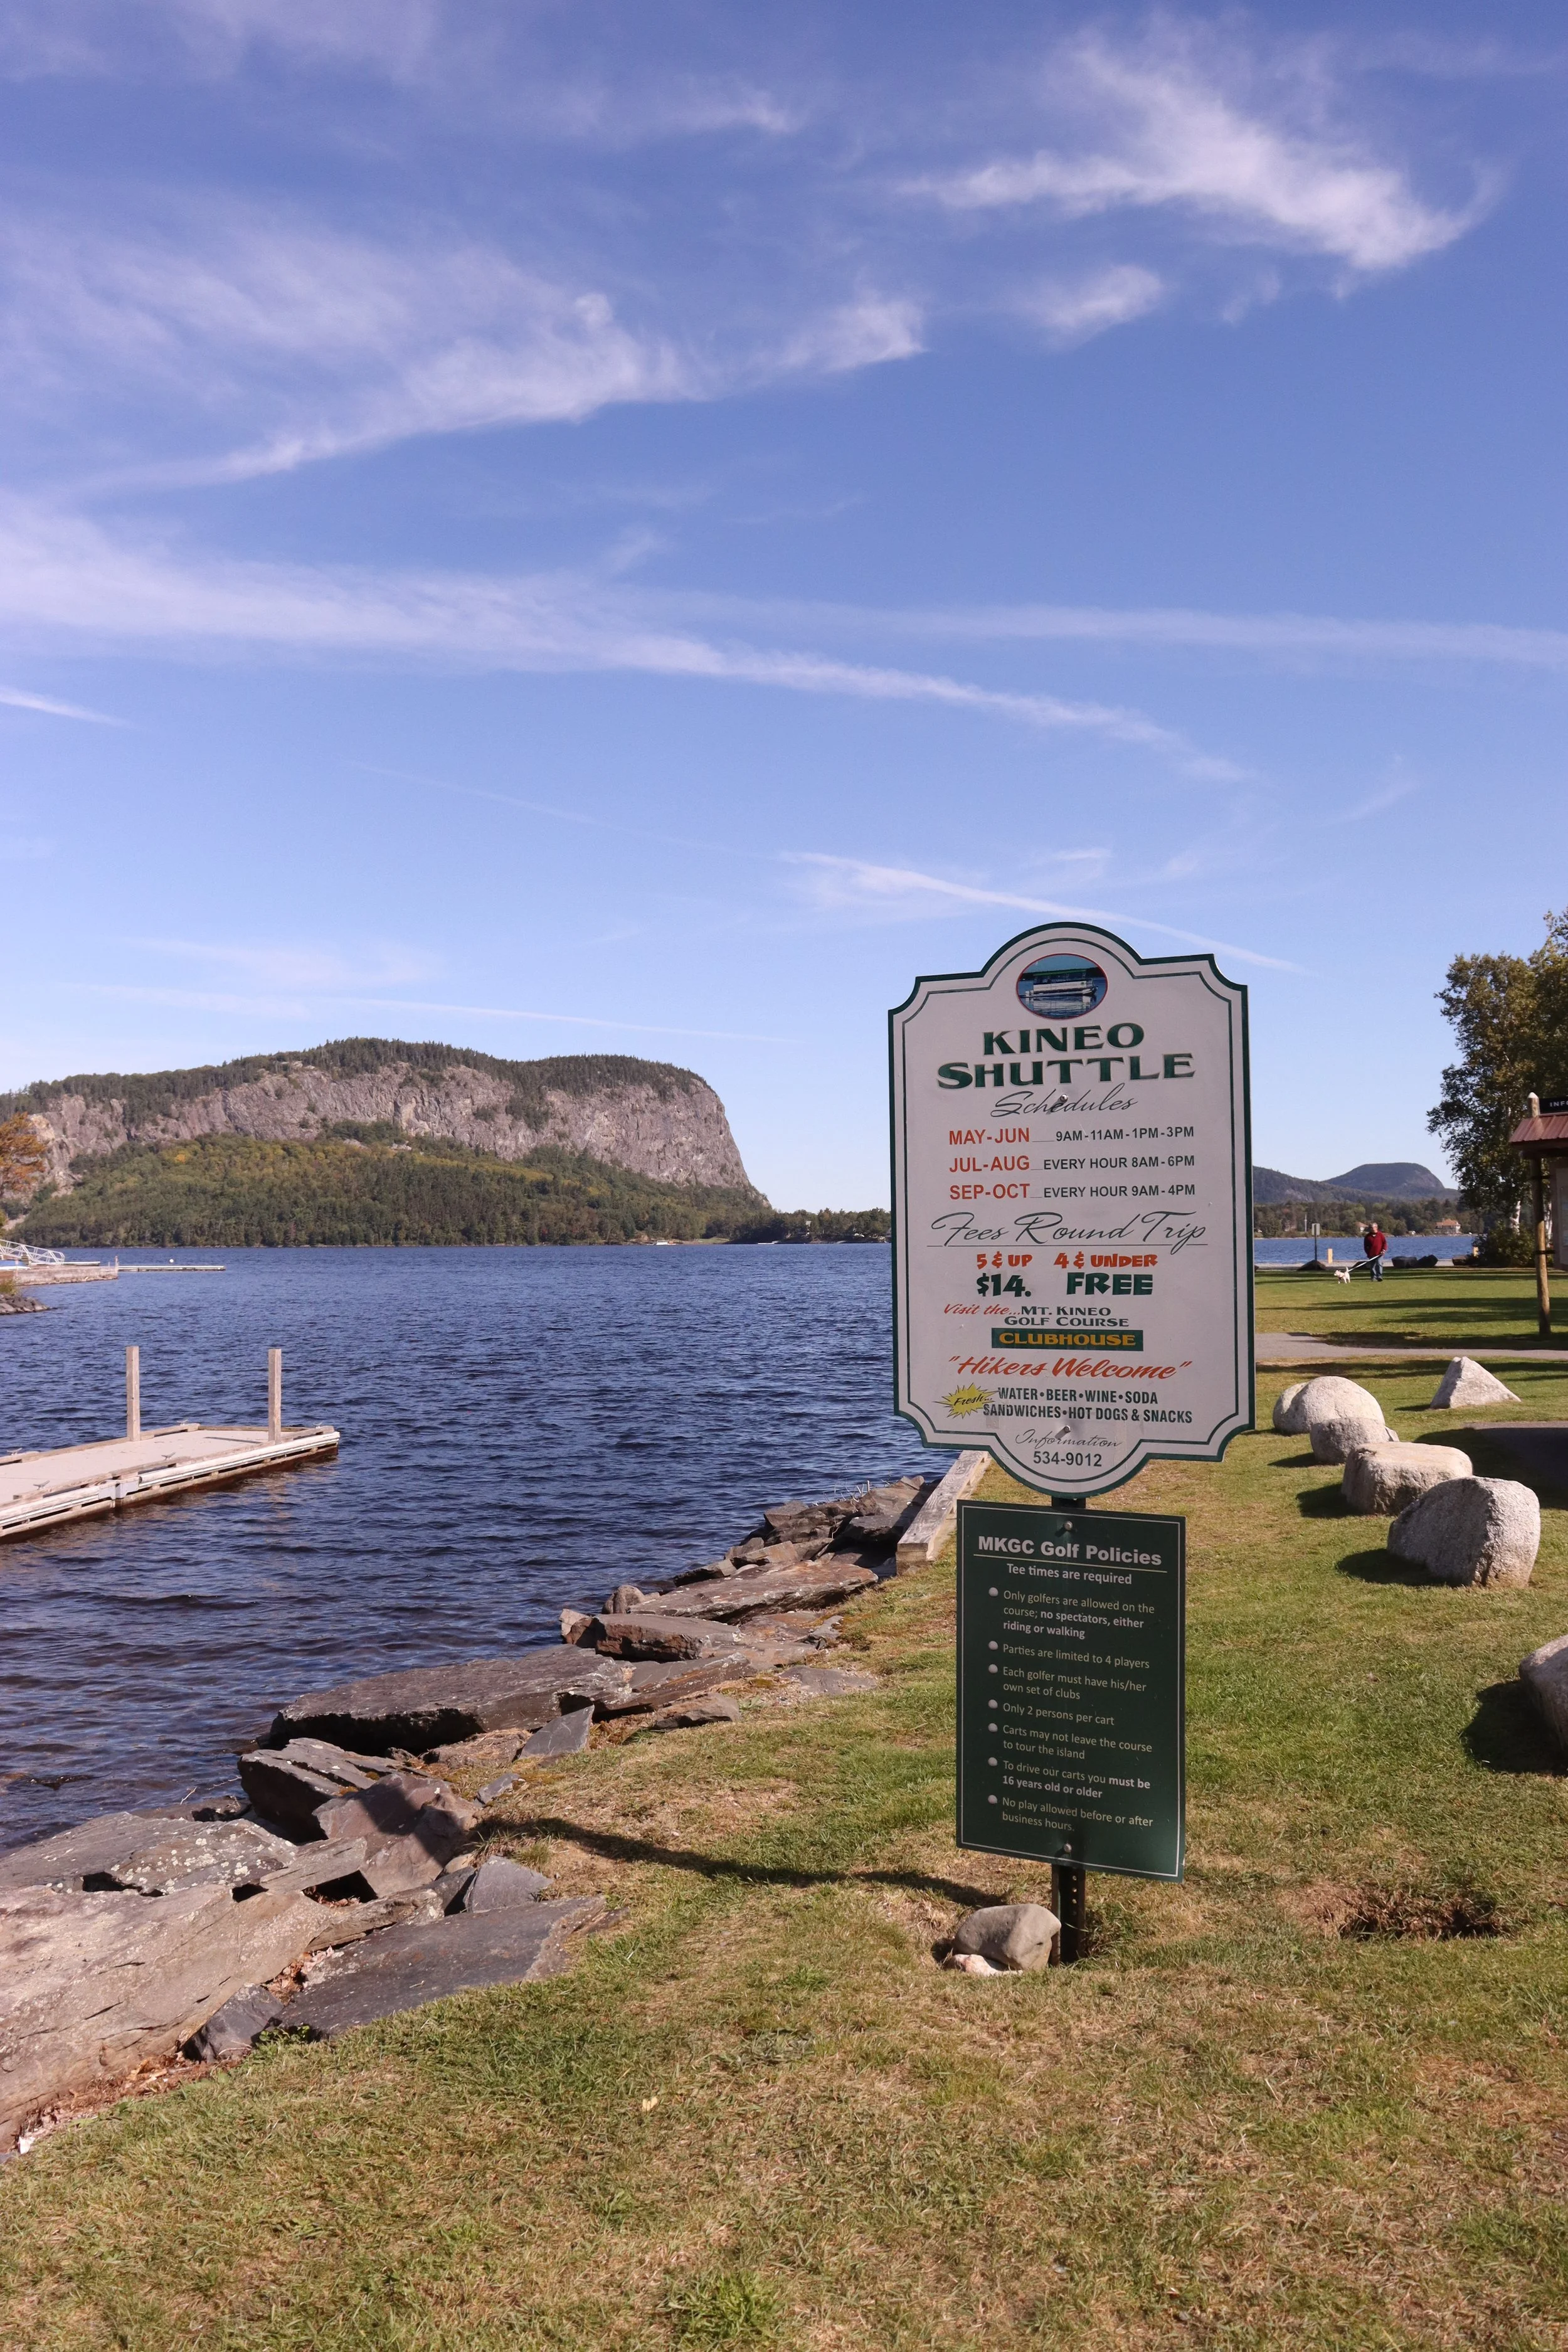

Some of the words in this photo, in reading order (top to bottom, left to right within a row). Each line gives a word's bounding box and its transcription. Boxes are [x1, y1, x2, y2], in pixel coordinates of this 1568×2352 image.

[983, 1022, 1145, 1056] KINEO
[937, 1053, 1196, 1089] SHUTTLE
[990, 1083, 1138, 1117] Schedules
[948, 1127, 1030, 1145] MAY-JUN
[949, 1155, 1030, 1172] JUL-AUG
[1044, 1158, 1086, 1170] EVERY
[1090, 1157, 1128, 1168] HOUR
[950, 1183, 1030, 1200] SEP-OCT
[1044, 1187, 1086, 1198] EVERY
[1090, 1185, 1128, 1197] HOUR
[931, 1212, 1009, 1246] Fees
[1014, 1211, 1140, 1244] Round
[1141, 1210, 1206, 1255] Trip
[977, 1254, 987, 1269] 5
[992, 1251, 1003, 1268] &
[1008, 1253, 1033, 1267] UP
[1054, 1253, 1069, 1269] 4
[1073, 1251, 1085, 1269] &
[1091, 1253, 1158, 1268] UNDER
[977, 1273, 1032, 1297] $14.
[1066, 1272, 1153, 1295] FREE
[944, 1304, 980, 1315] Visit
[1021, 1306, 1052, 1316] MT.
[1057, 1306, 1111, 1316] KINEO
[1004, 1316, 1049, 1325] GOLF
[1056, 1317, 1129, 1327] COURSE
[999, 1333, 1136, 1346] CLUBHOUSE
[1096, 1408, 1128, 1421] DOGS
[1131, 1409, 1140, 1421] &
[1143, 1409, 1192, 1424] SNACKS
[1015, 1429, 1122, 1449] Information
[1033, 1451, 1102, 1467] 534-9012
[978, 1535, 1034, 1554] MKGC
[1041, 1541, 1079, 1559] Golf
[1086, 1545, 1162, 1565] Policies
[1007, 1563, 1025, 1575] Tee
[1029, 1565, 1059, 1578] times
[1062, 1571, 1080, 1580] are
[1083, 1572, 1132, 1585] required
[1004, 1590, 1025, 1603] Only
[1028, 1593, 1060, 1604] golfers
[1062, 1597, 1078, 1606] are
[1081, 1597, 1120, 1610] allowed
[1122, 1604, 1135, 1612] on
[1138, 1602, 1155, 1614] the
[1004, 1607, 1038, 1619] course;
[1041, 1611, 1053, 1619] no
[1056, 1611, 1111, 1627] spectators,
[1113, 1616, 1144, 1628] either
[1003, 1621, 1031, 1634] riding
[1033, 1625, 1044, 1633] or
[1046, 1626, 1085, 1640] walking
[1003, 1643, 1035, 1656] Parties
[1037, 1650, 1053, 1658] are
[1056, 1649, 1090, 1663] limited
[1092, 1655, 1103, 1663] to
[1105, 1655, 1112, 1665] 4
[1114, 1656, 1150, 1669] players
[1003, 1666, 1025, 1678] Each
[1027, 1670, 1055, 1681] golfer
[1057, 1674, 1082, 1685] must
[1084, 1676, 1108, 1687] have
[1111, 1679, 1147, 1692] his/her
[1003, 1683, 1024, 1692] own
[1026, 1685, 1041, 1695] set
[1042, 1687, 1054, 1696] of
[1056, 1688, 1081, 1700] clubs
[1003, 1702, 1025, 1716] Only
[1027, 1705, 1033, 1715] 2
[1036, 1708, 1074, 1720] persons
[1076, 1714, 1093, 1723] per
[1095, 1716, 1115, 1725] cart
[1003, 1725, 1027, 1737] Carts
[1029, 1730, 1050, 1742] may
[1052, 1732, 1069, 1742] not
[1071, 1733, 1097, 1746] leave
[1099, 1737, 1116, 1748] the
[1119, 1741, 1153, 1752] course
[1003, 1740, 1013, 1749] to
[1015, 1741, 1036, 1752] tour
[1039, 1744, 1054, 1755] the
[1057, 1747, 1085, 1759] island
[1003, 1760, 1014, 1770] To
[1016, 1762, 1041, 1774] drive
[1042, 1768, 1060, 1777] our
[1062, 1771, 1086, 1781] carts
[1088, 1774, 1106, 1784] you
[1108, 1777, 1135, 1787] must
[1137, 1778, 1150, 1789] be
[1003, 1775, 1014, 1785] 16
[1016, 1779, 1042, 1789] years
[1044, 1782, 1061, 1792] old
[1062, 1786, 1074, 1794] or
[1076, 1786, 1103, 1798] older
[1002, 1797, 1016, 1807] No
[1018, 1800, 1038, 1813] play
[1040, 1803, 1078, 1817] allowed
[1080, 1808, 1113, 1822] before
[1115, 1816, 1126, 1824] or
[1128, 1815, 1153, 1826] after
[1002, 1811, 1042, 1826] business
[1045, 1818, 1075, 1832] hours.
